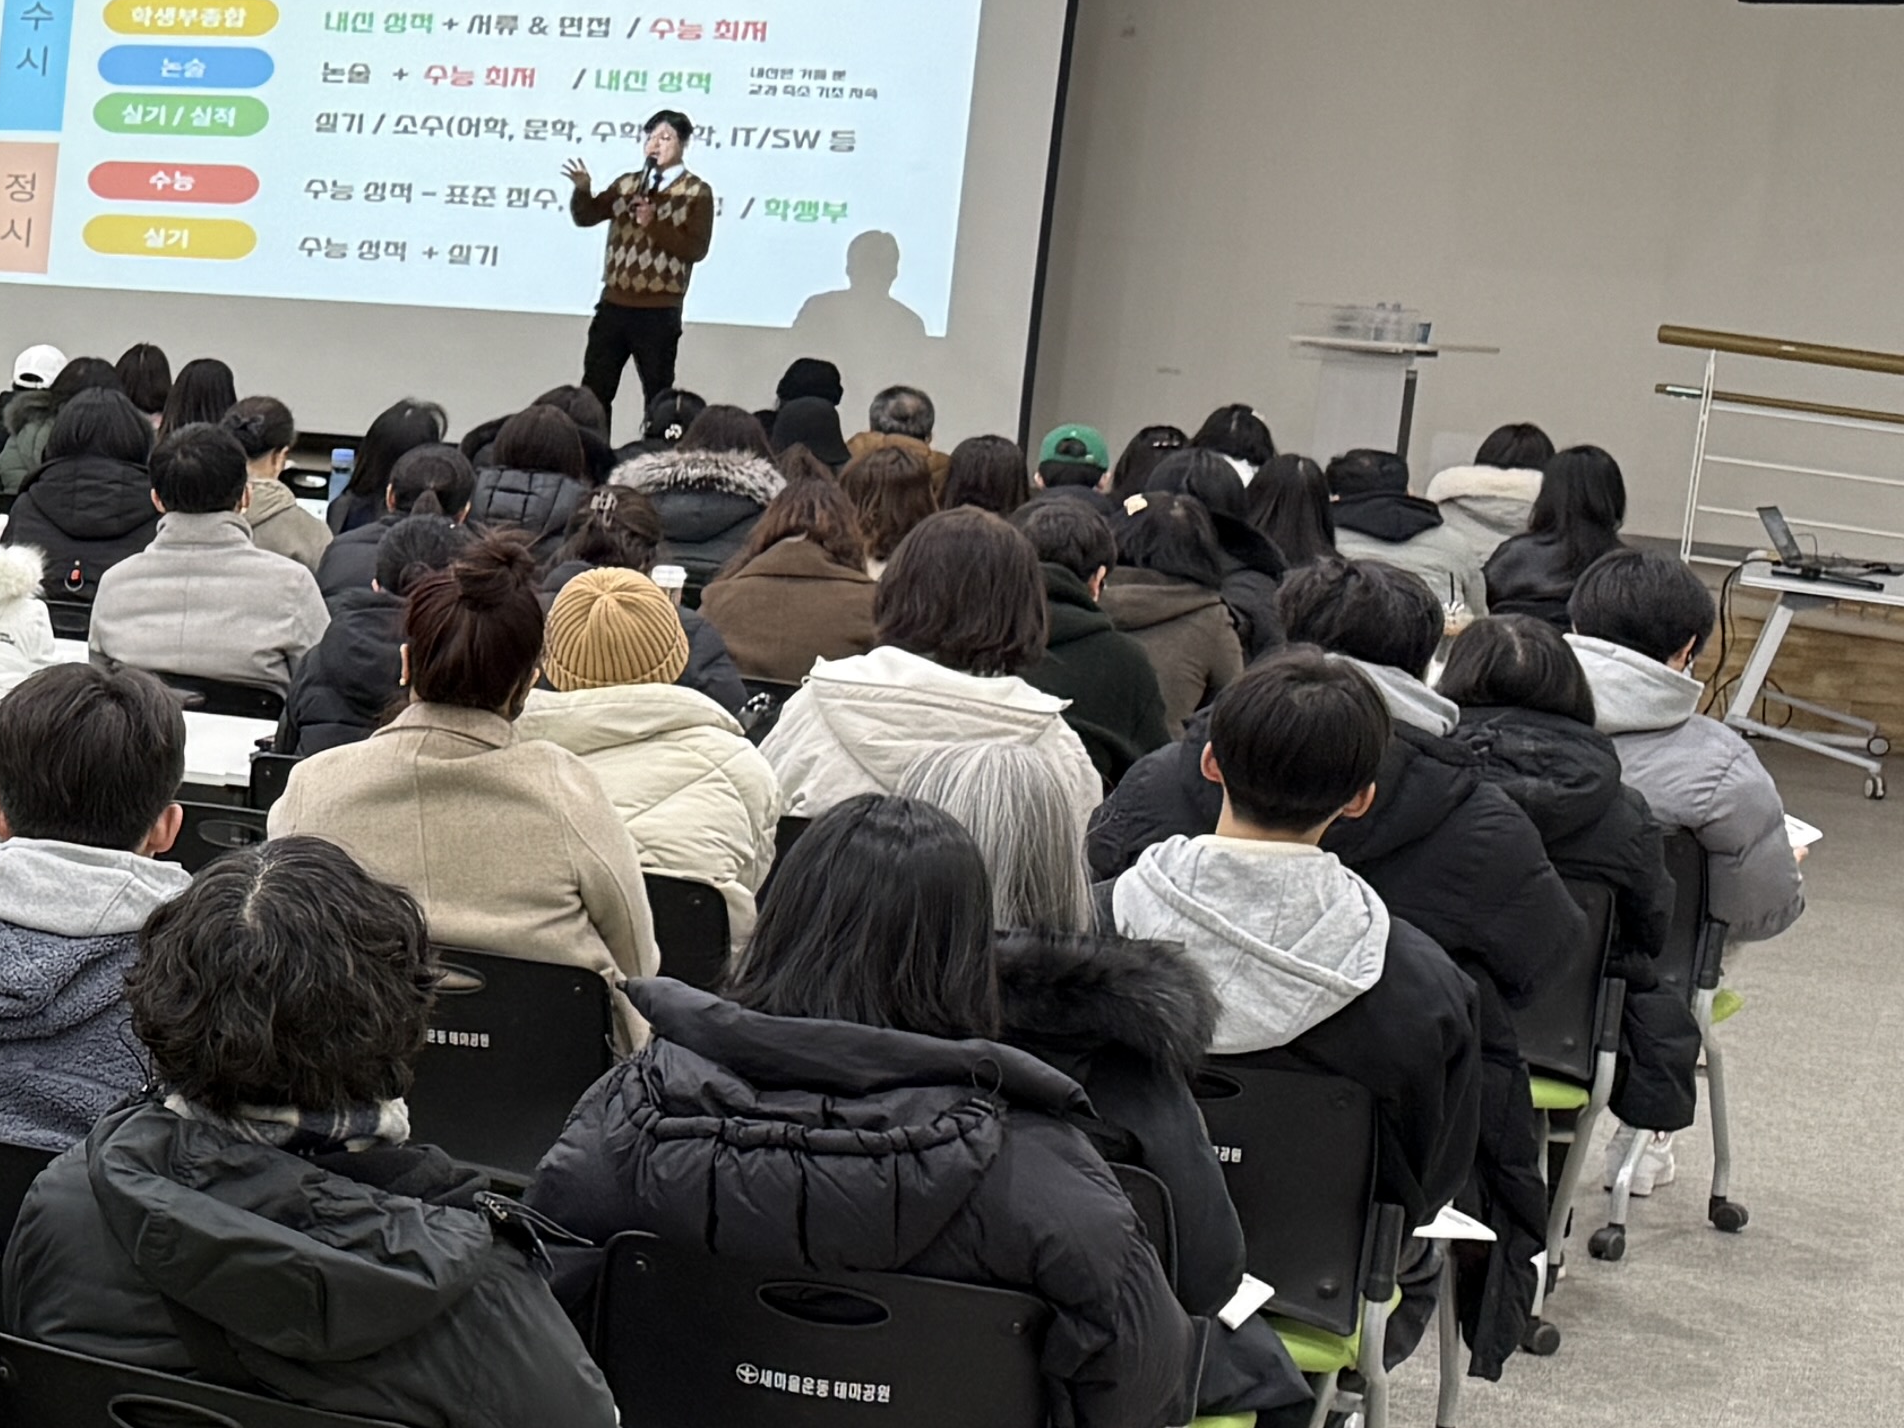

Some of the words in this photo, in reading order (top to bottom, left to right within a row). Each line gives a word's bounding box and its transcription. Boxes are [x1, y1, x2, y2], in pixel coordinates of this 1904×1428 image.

[130, 5, 248, 30] 학생부종합
[324, 10, 375, 35] 내신
[383, 11, 435, 35] 성적
[466, 13, 520, 36] 서류
[558, 15, 612, 39] 면접
[649, 17, 704, 41] 수능
[712, 18, 769, 43] 최저
[159, 56, 207, 80] 논술
[321, 61, 372, 86] 논술
[423, 63, 476, 88] 수능
[484, 65, 537, 89] 최저
[593, 68, 648, 93] 내신
[657, 69, 713, 95] 성적
[121, 103, 169, 127] 실기
[190, 104, 237, 129] 실적
[314, 111, 365, 136] 실기
[522, 117, 583, 145] 문학,
[730, 126, 821, 152] IT/SW
[828, 128, 857, 153] 등
[149, 169, 196, 193] 수능
[304, 178, 356, 203] 수능
[363, 179, 415, 204] 성적
[443, 183, 498, 209] 표준
[763, 197, 850, 225] 학생부
[143, 226, 191, 250] 실기
[297, 235, 350, 260] 수능
[357, 237, 408, 262] 성적
[447, 243, 500, 268] 실기
